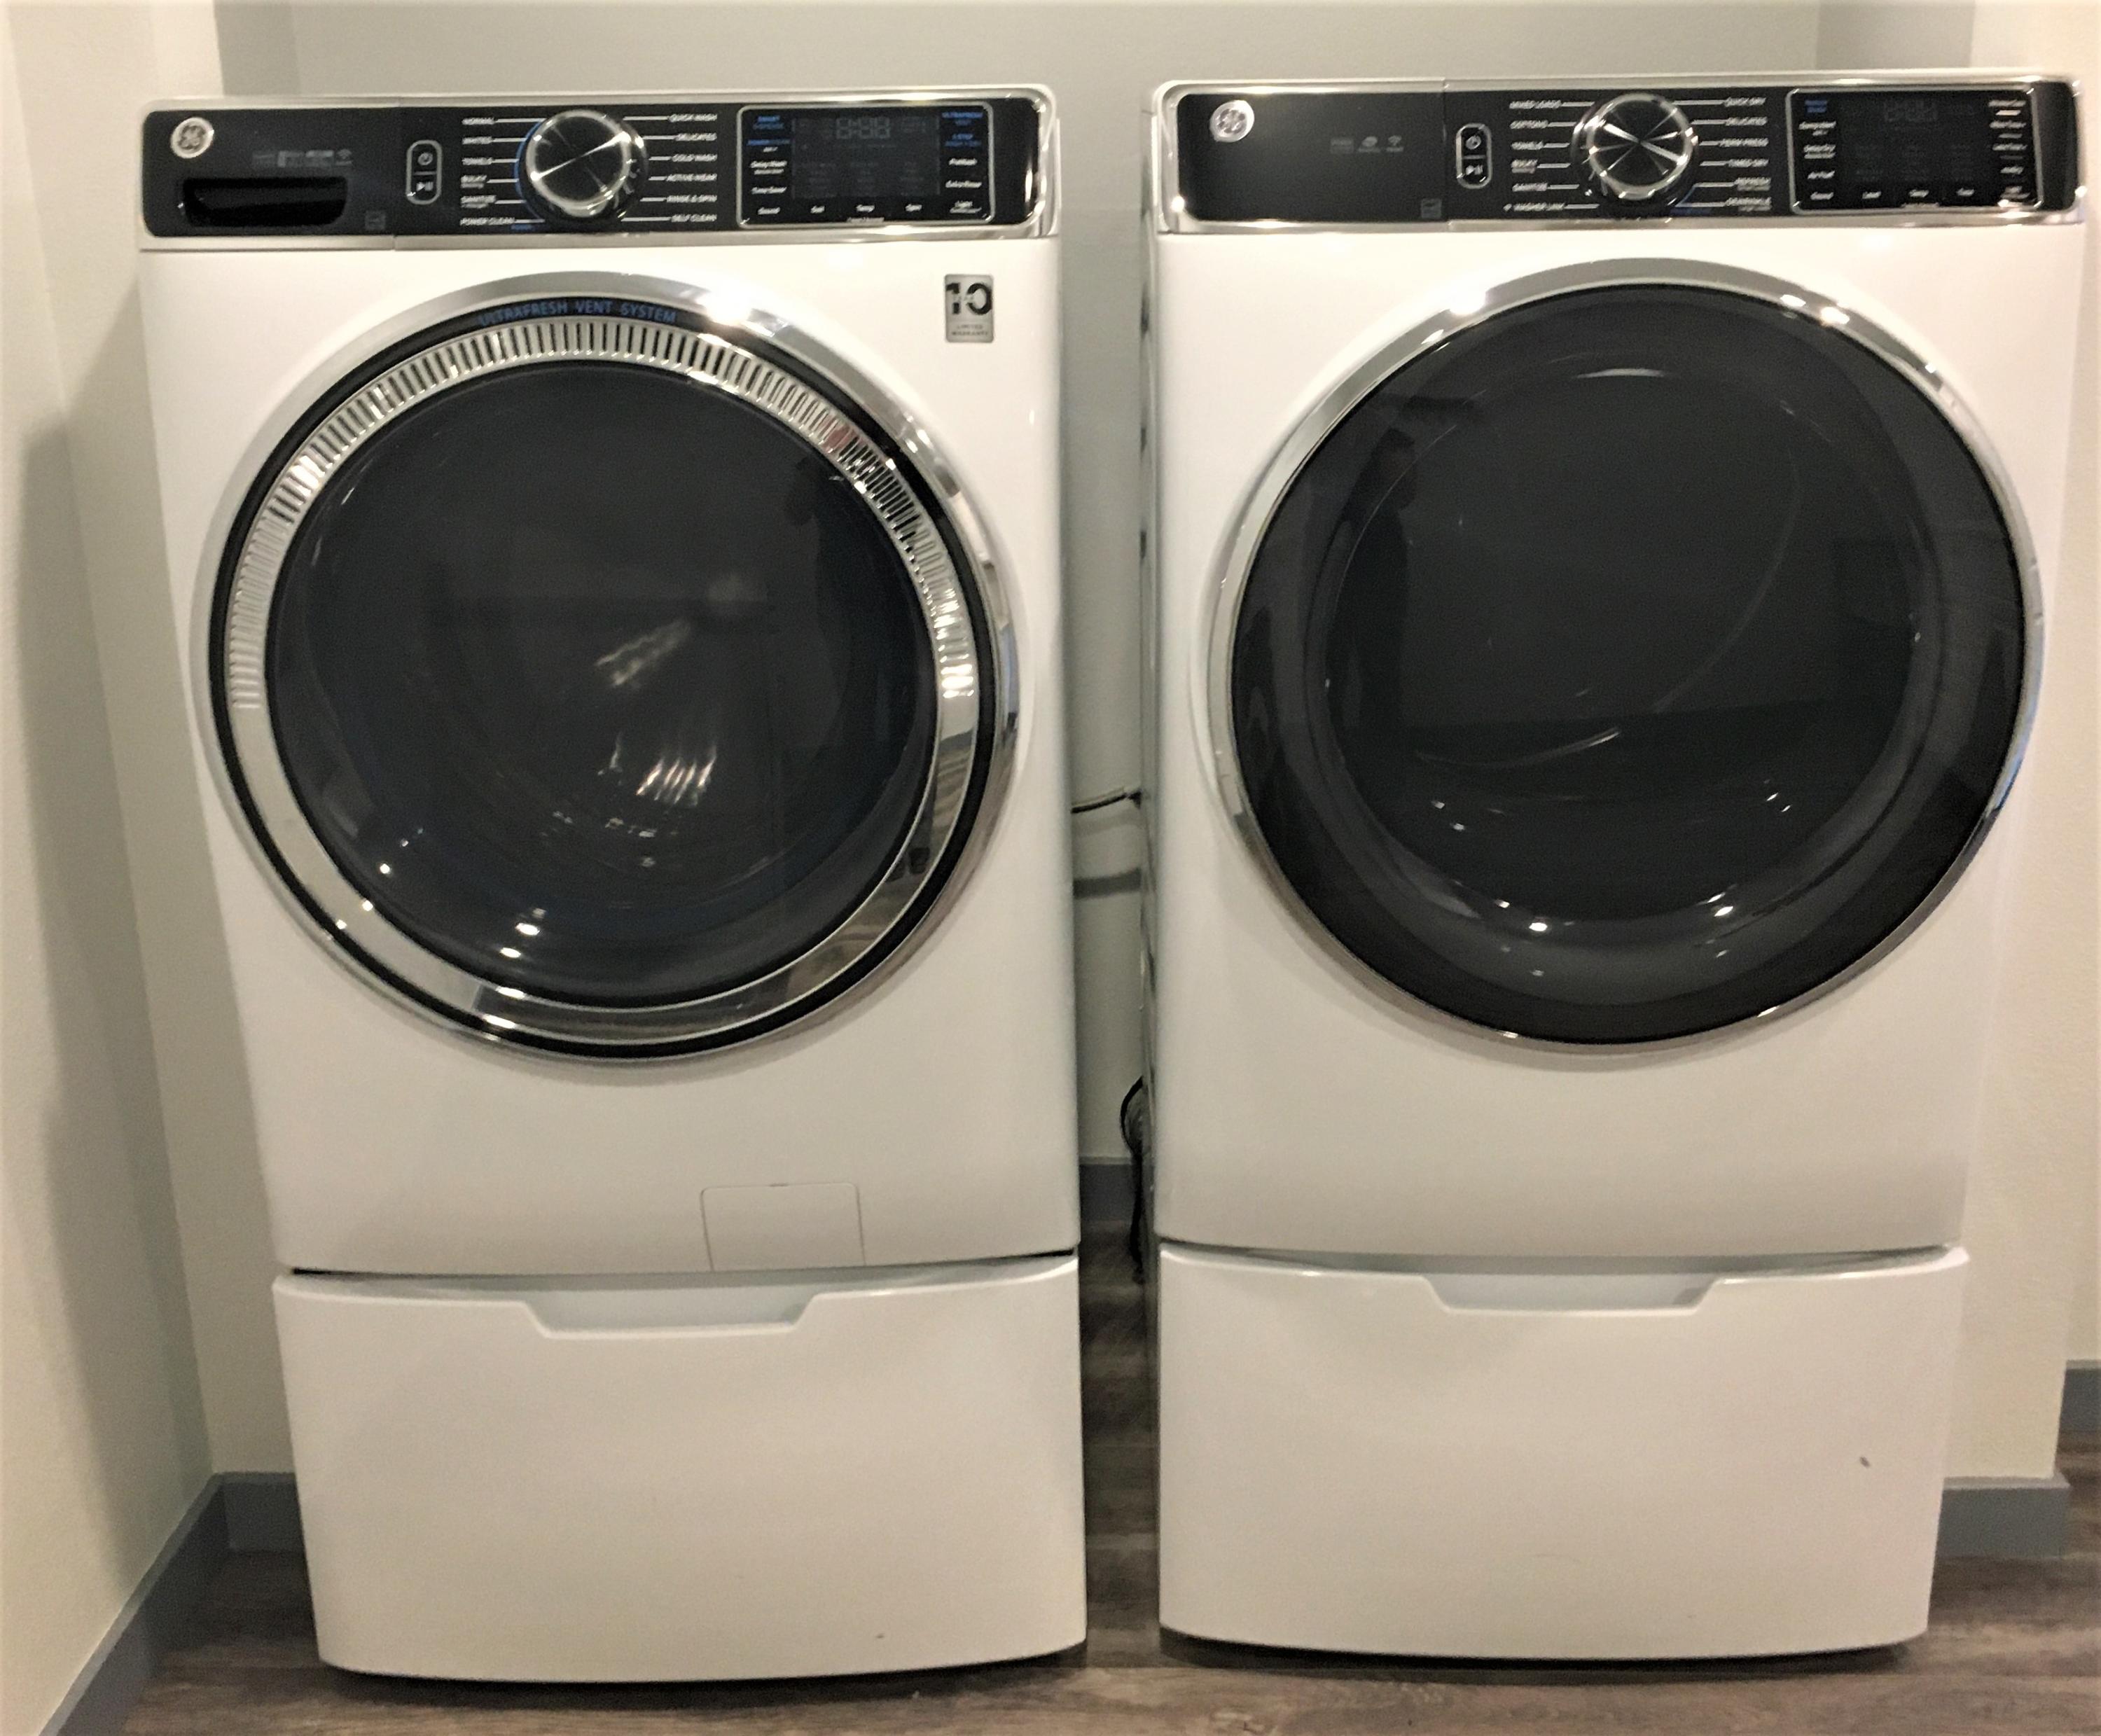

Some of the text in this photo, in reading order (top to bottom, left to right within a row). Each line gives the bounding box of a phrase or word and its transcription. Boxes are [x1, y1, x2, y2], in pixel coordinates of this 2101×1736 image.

[477, 300, 677, 327] ULTRAFRESH VENT SYSTEM
[946, 282, 992, 315] 10
